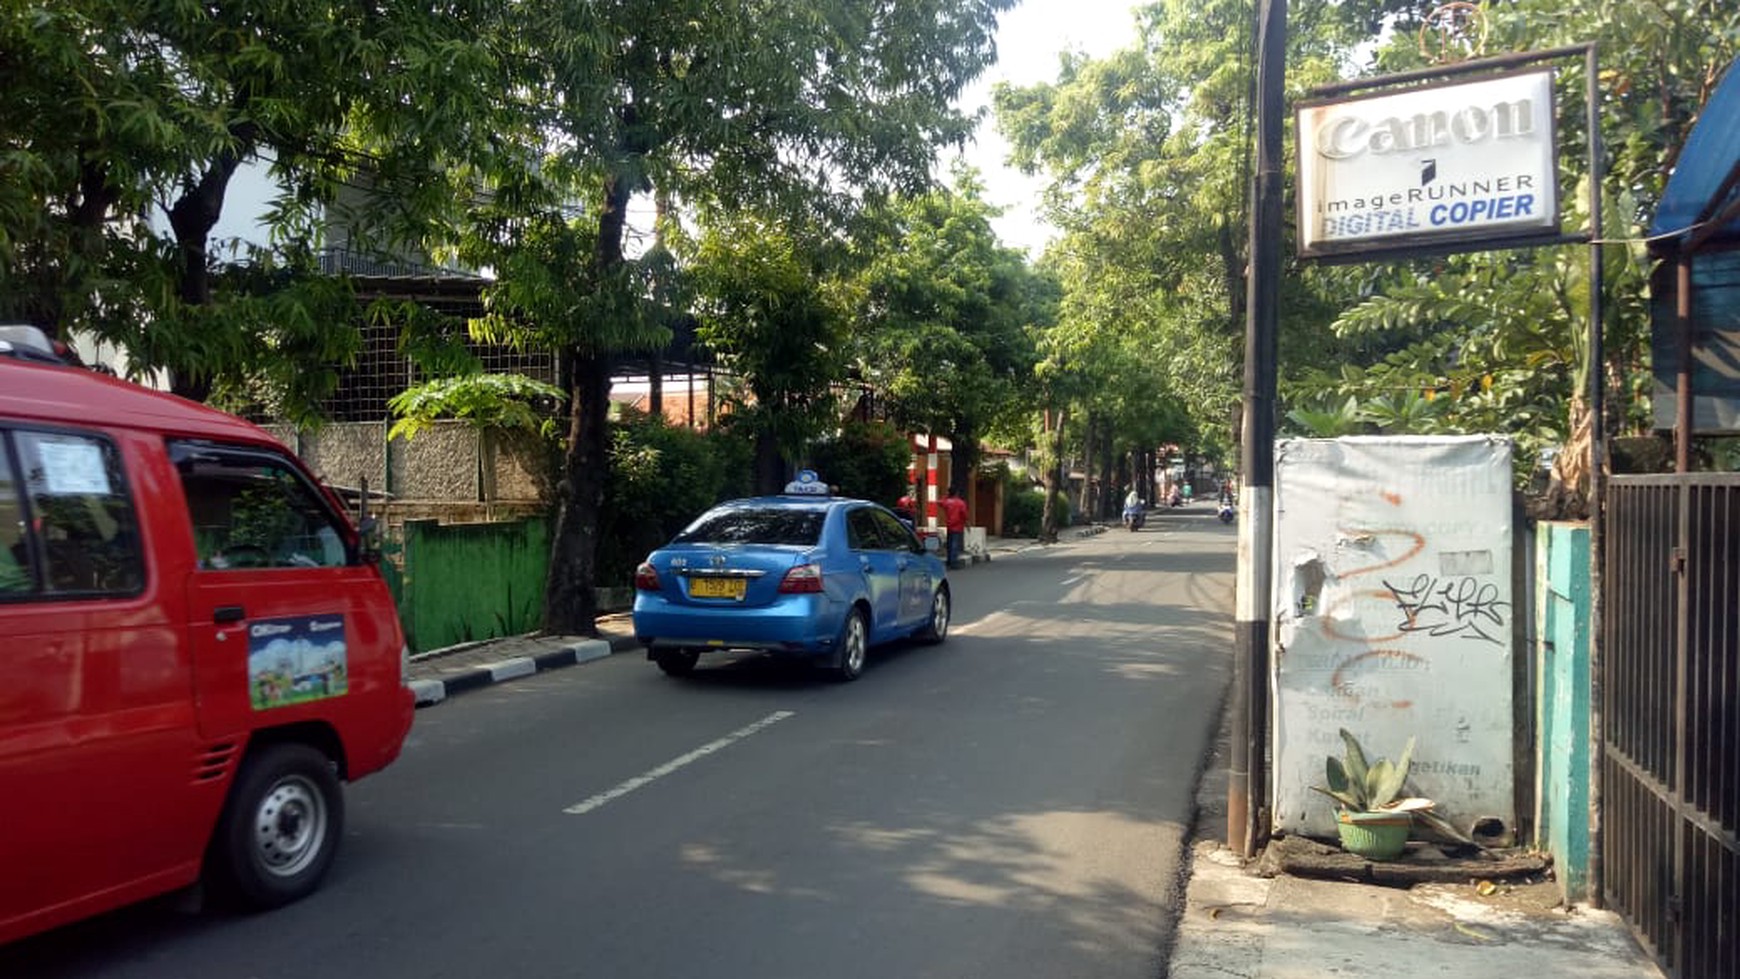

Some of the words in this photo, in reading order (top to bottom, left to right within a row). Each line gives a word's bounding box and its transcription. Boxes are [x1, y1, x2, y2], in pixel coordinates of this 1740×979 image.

[1317, 98, 1534, 158] Canon
[1318, 175, 1534, 213] imageRUNNER
[1325, 208, 1420, 236] DIGITAL
[1430, 194, 1534, 226] COPIER
